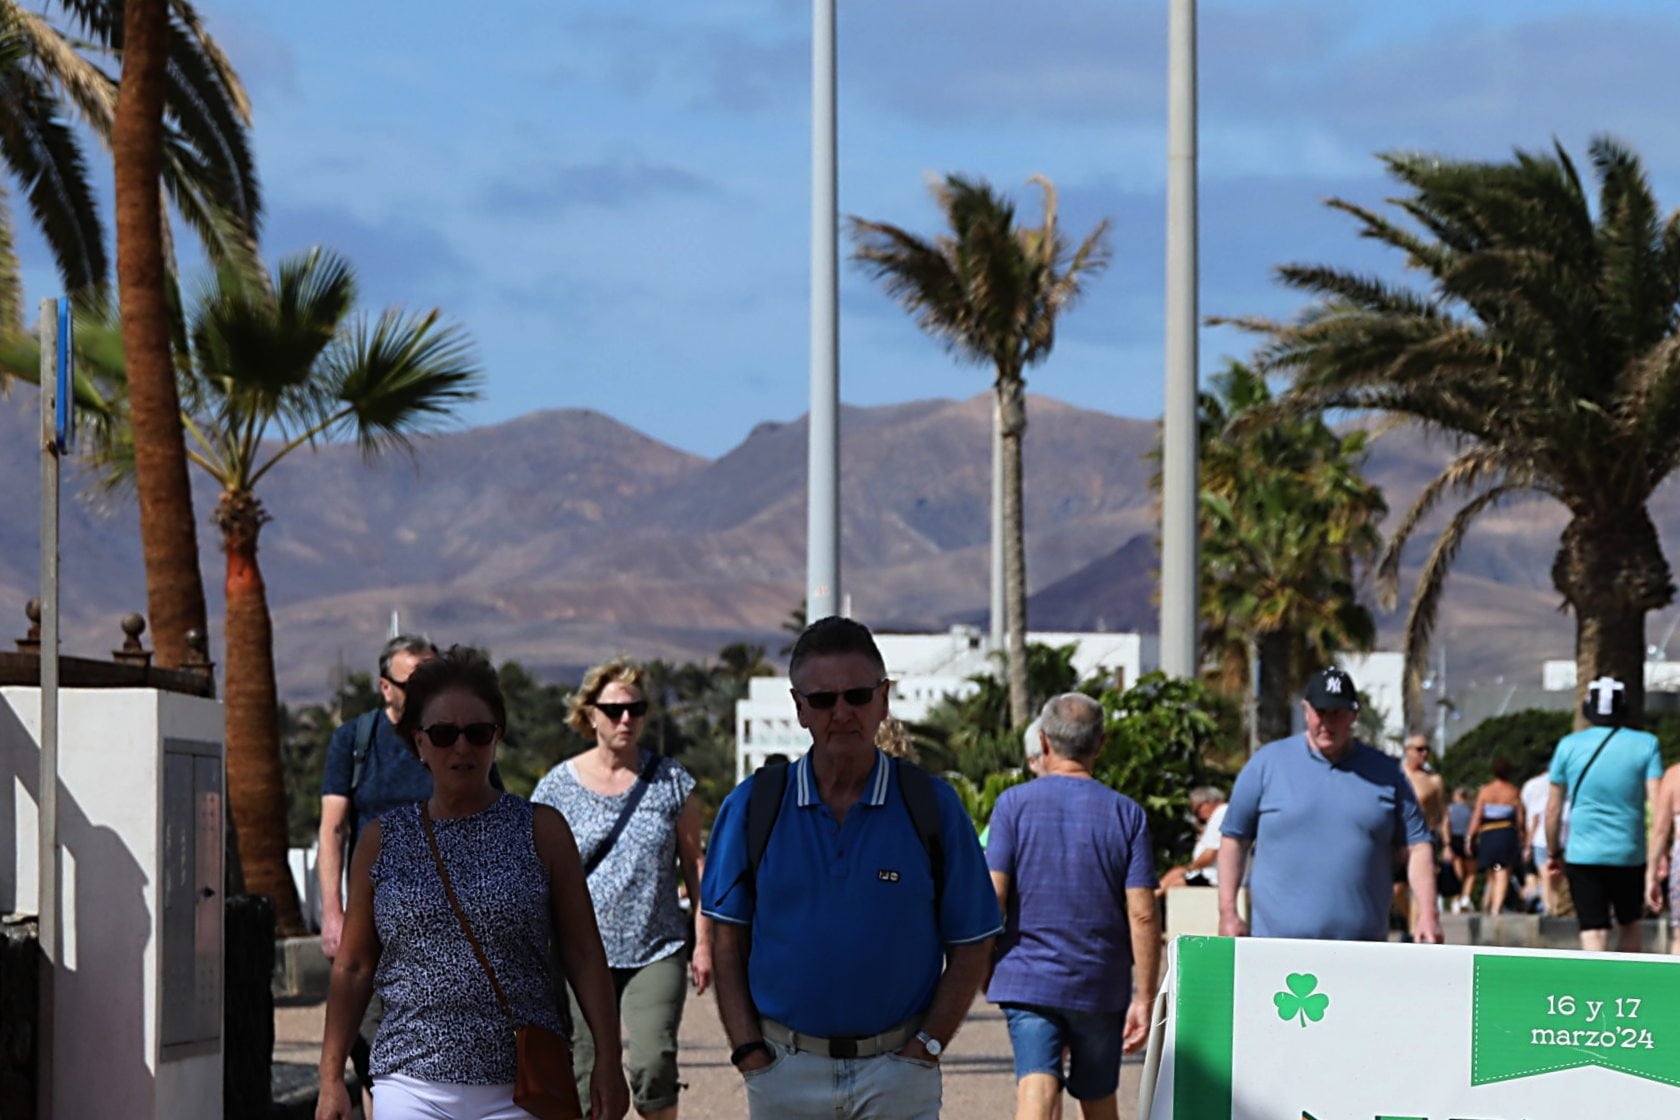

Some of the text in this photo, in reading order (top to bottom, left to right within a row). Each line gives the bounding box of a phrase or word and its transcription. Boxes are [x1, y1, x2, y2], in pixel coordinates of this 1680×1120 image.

[1546, 994, 1642, 1022] 16 y 17
